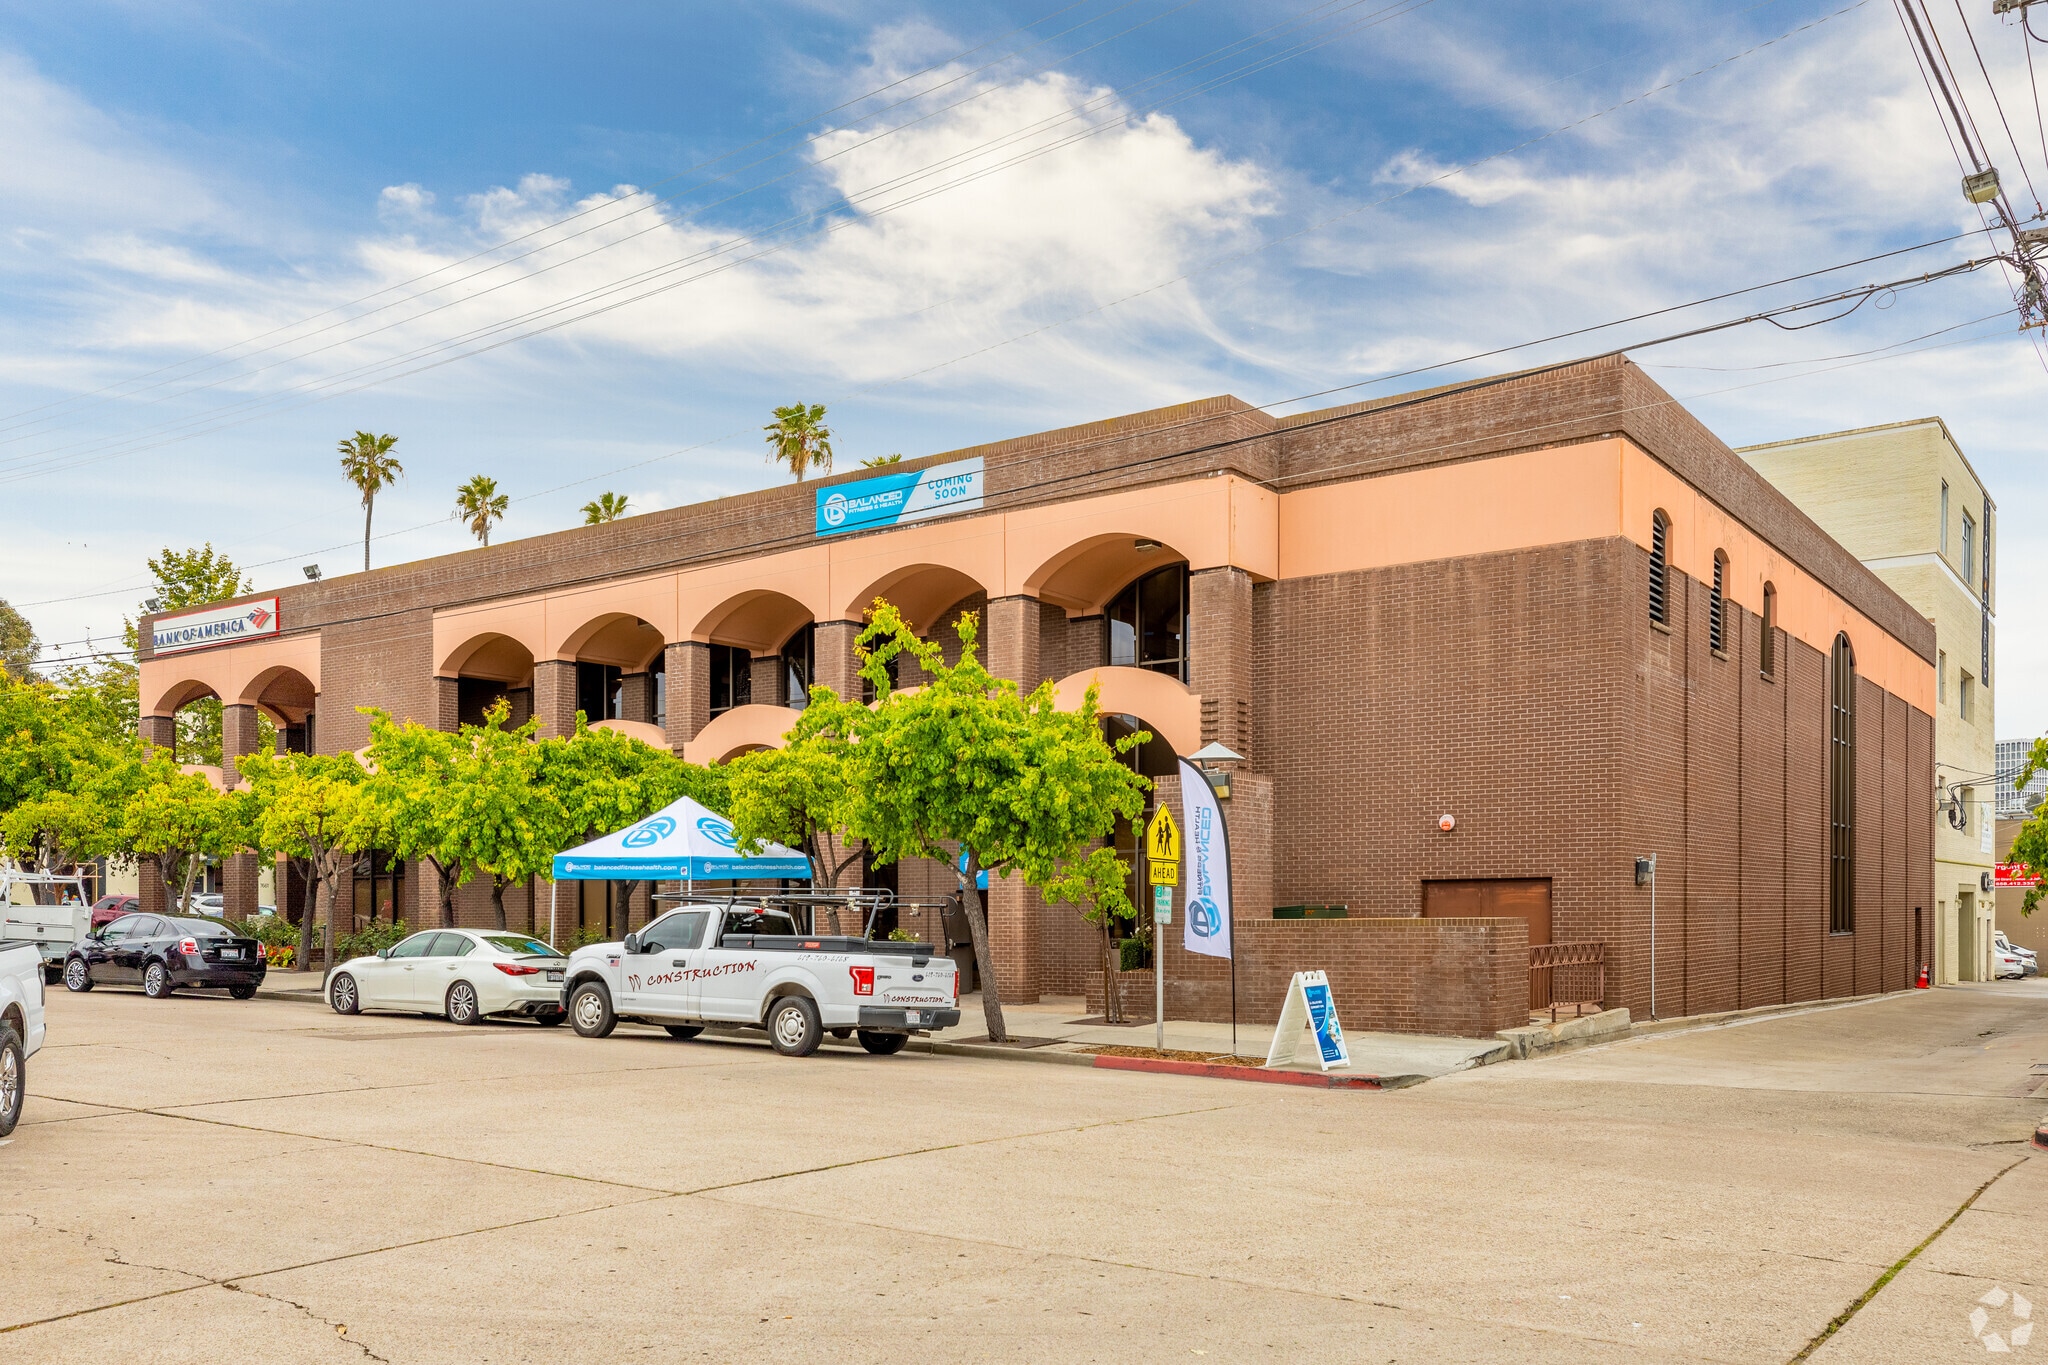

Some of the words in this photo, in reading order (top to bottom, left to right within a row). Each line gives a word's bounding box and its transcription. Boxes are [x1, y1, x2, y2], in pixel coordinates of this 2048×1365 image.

[928, 474, 973, 490] COMING
[848, 490, 903, 509] BALANCED
[934, 485, 966, 500] SOON
[848, 505, 873, 514] FITNESS
[879, 499, 903, 509] HEALTH
[153, 632, 180, 646] BANK
[182, 628, 195, 640] OF
[197, 619, 245, 638] AMERICA
[1153, 867, 1175, 879] AHEAD
[1156, 886, 1162, 896] 2
[647, 959, 758, 986] CONSTRUCTION
[891, 995, 945, 1004] CONSTRUCTION
